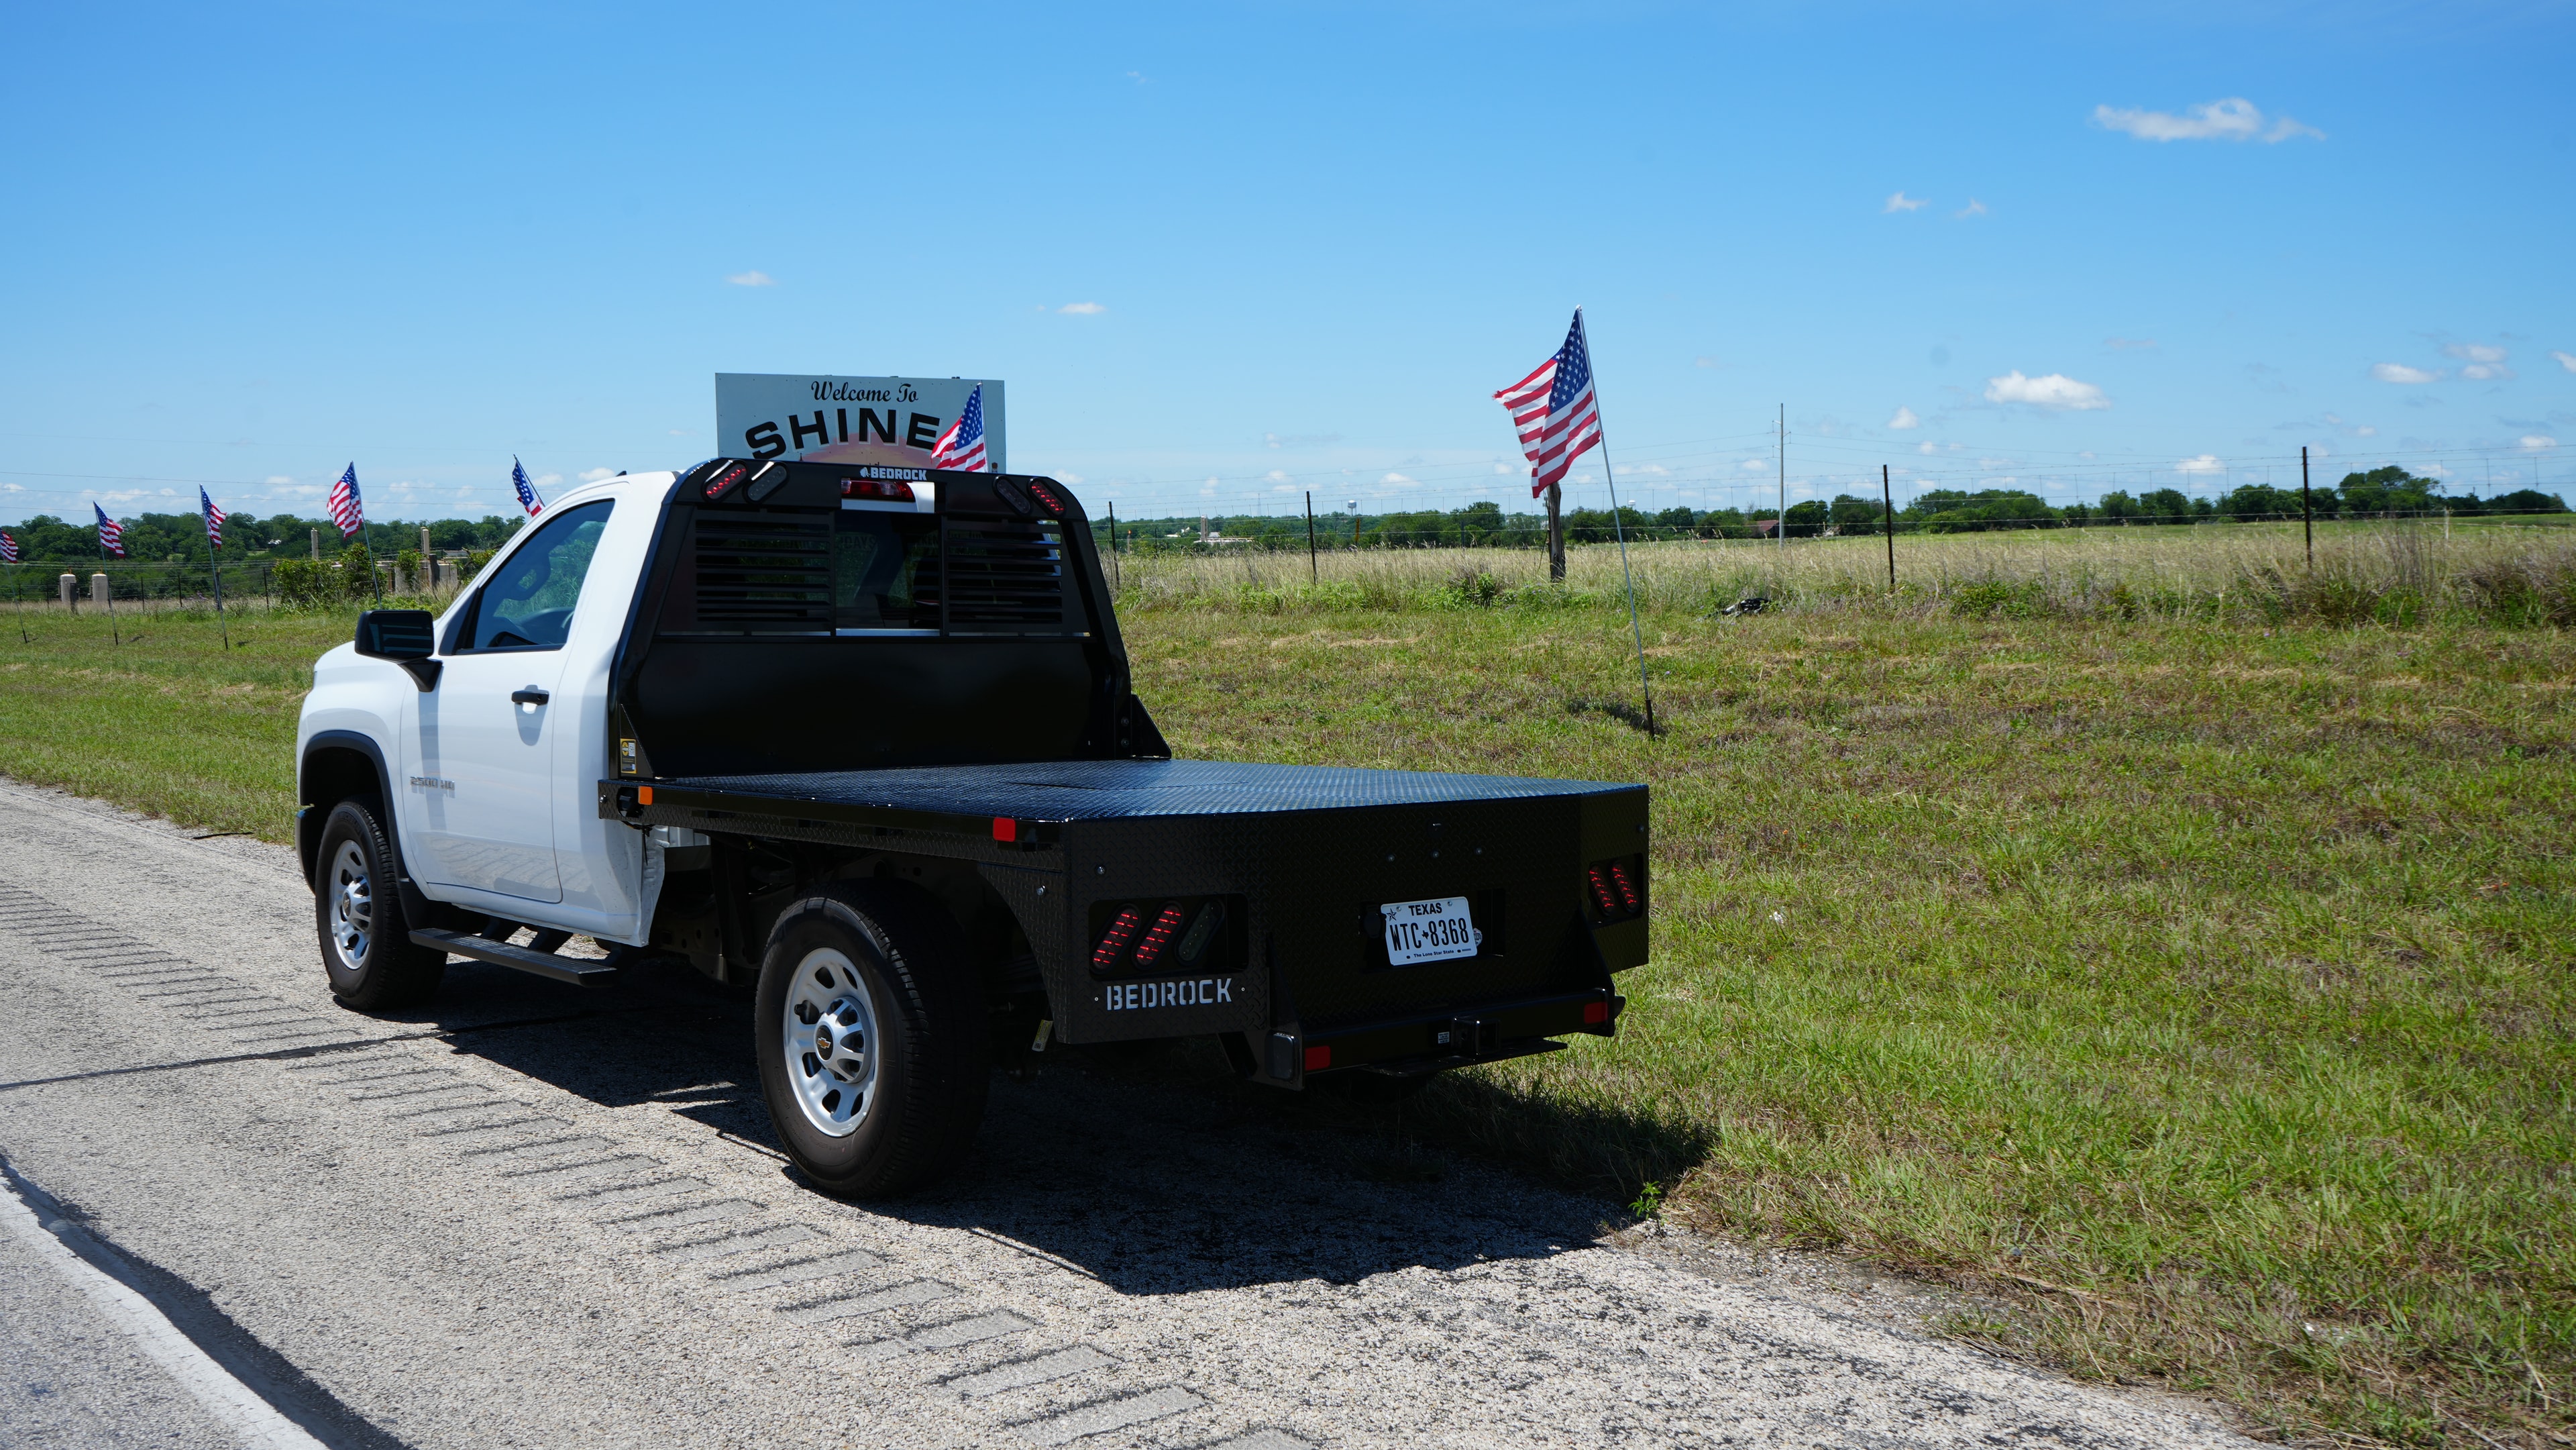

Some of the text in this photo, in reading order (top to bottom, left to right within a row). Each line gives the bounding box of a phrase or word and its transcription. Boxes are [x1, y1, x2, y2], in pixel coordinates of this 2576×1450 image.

[811, 380, 919, 403] Welcome To
[745, 407, 941, 460] SHINE
[871, 467, 927, 481] BEDROCK
[410, 776, 455, 790] 2500 HD
[1408, 902, 1442, 917] TEXAS
[1106, 978, 1232, 1011] BEDROCK
